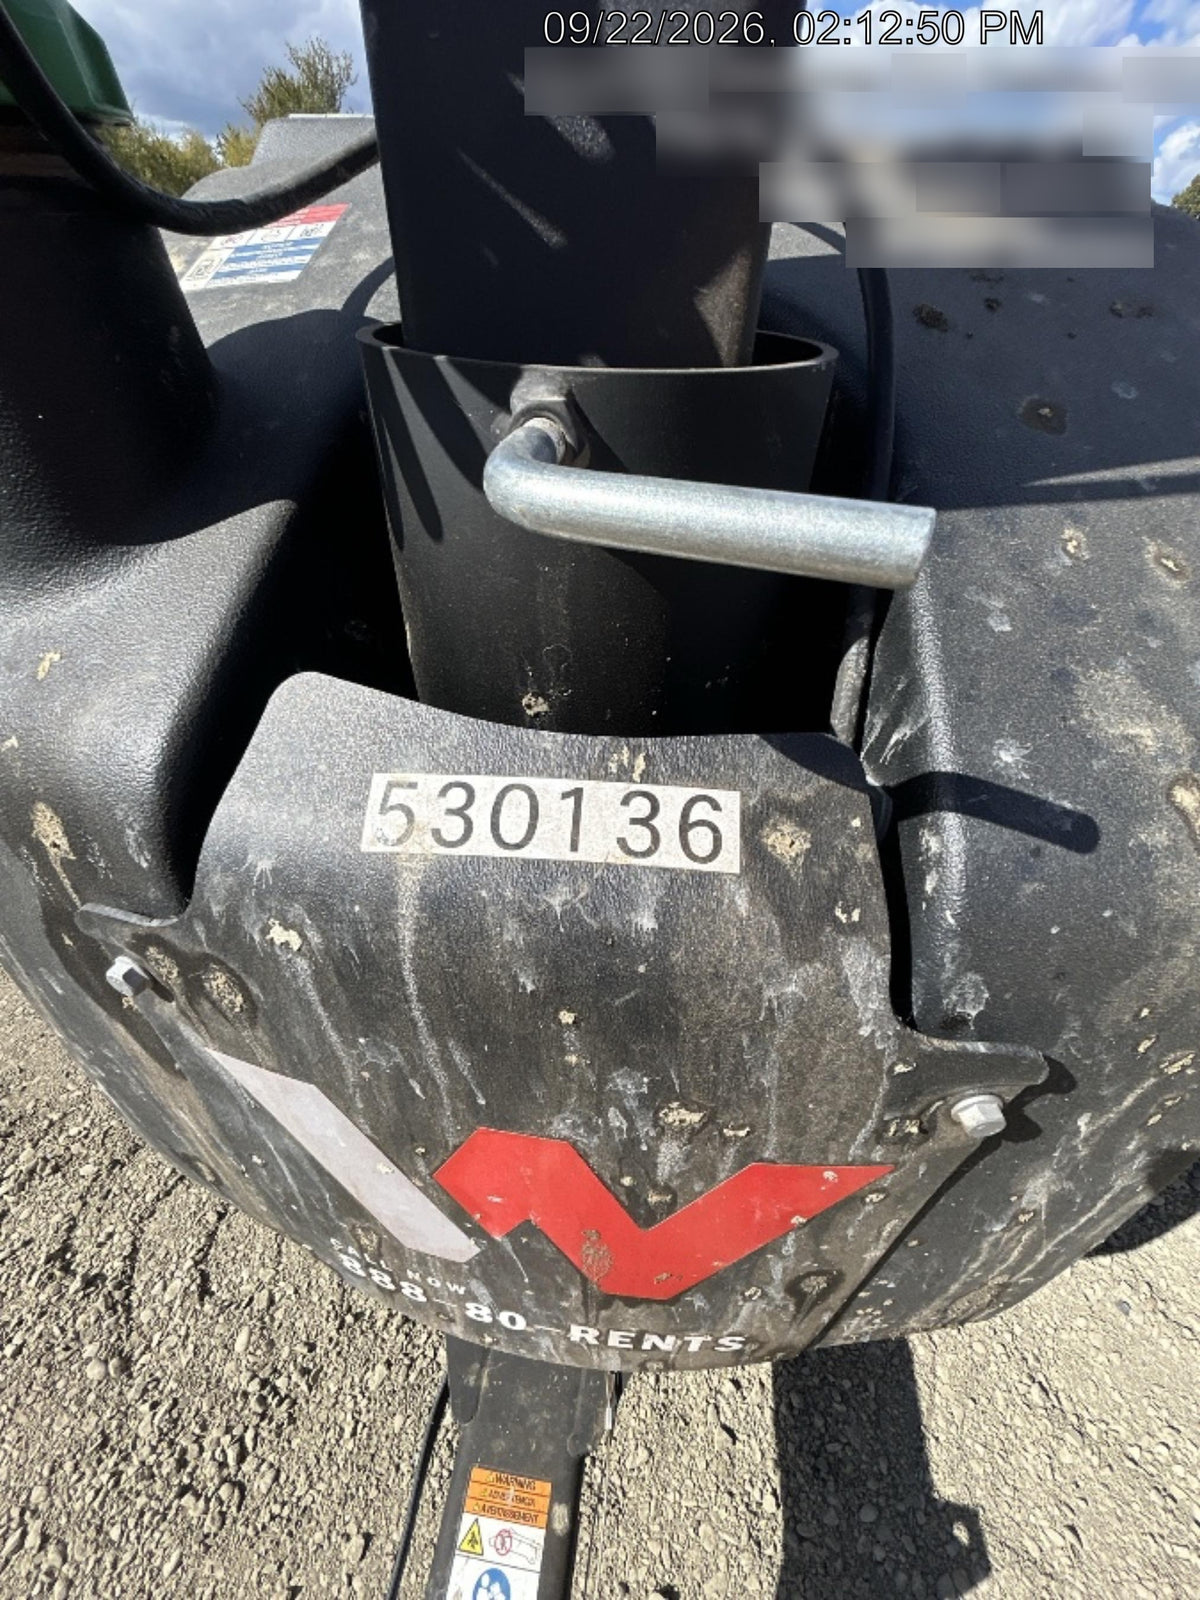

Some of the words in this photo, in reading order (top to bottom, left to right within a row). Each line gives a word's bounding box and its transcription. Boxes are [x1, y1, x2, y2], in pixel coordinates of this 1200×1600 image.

[374, 780, 723, 864] 530136
[329, 1236, 394, 1272] CALL
[406, 1268, 466, 1295] NOW
[495, 1473, 536, 1490] WARNING
